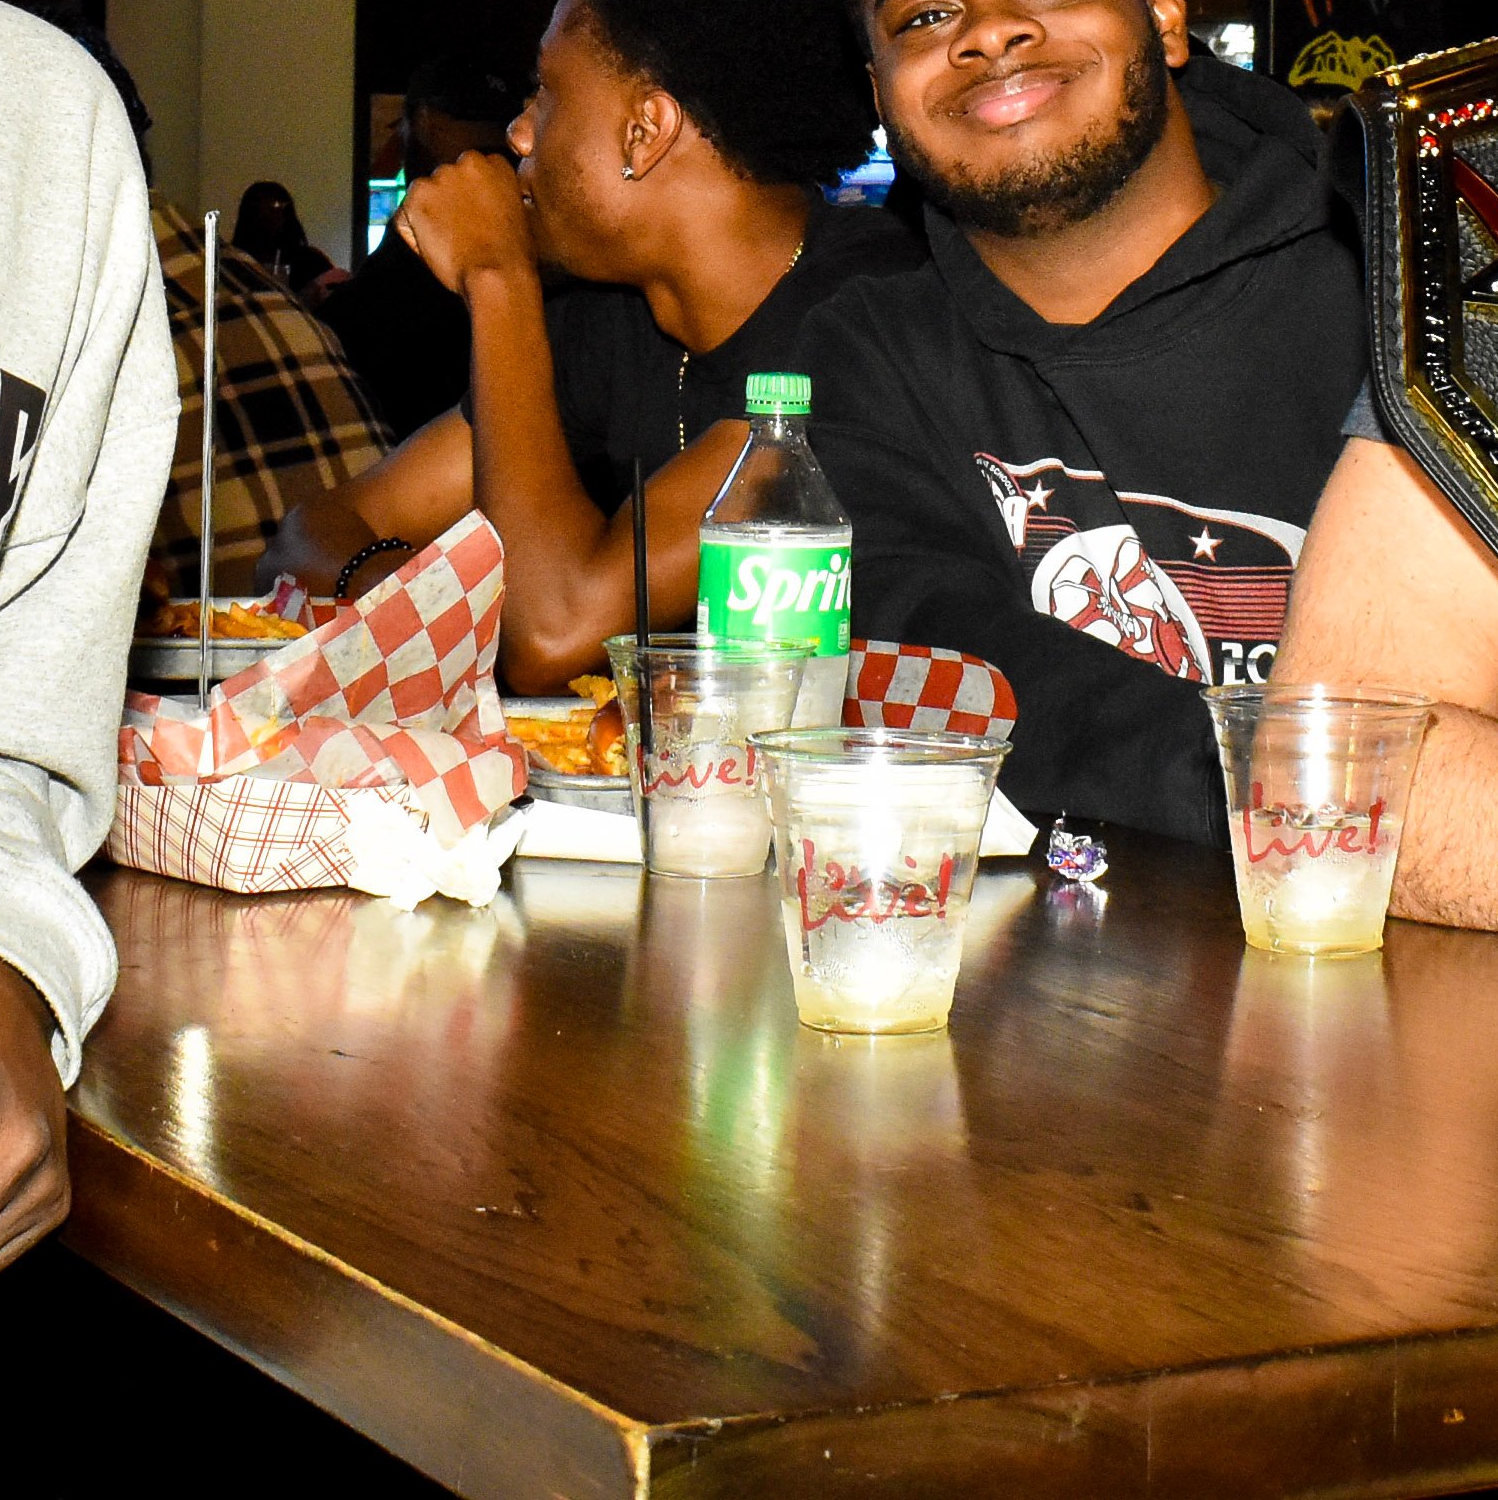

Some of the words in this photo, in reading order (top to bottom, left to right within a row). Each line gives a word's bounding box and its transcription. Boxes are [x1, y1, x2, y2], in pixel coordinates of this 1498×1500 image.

[989, 464, 1016, 496] SCHOOLS
[726, 553, 851, 626] Sprit
[636, 743, 756, 795] Live!
[1242, 800, 1383, 863] Live!
